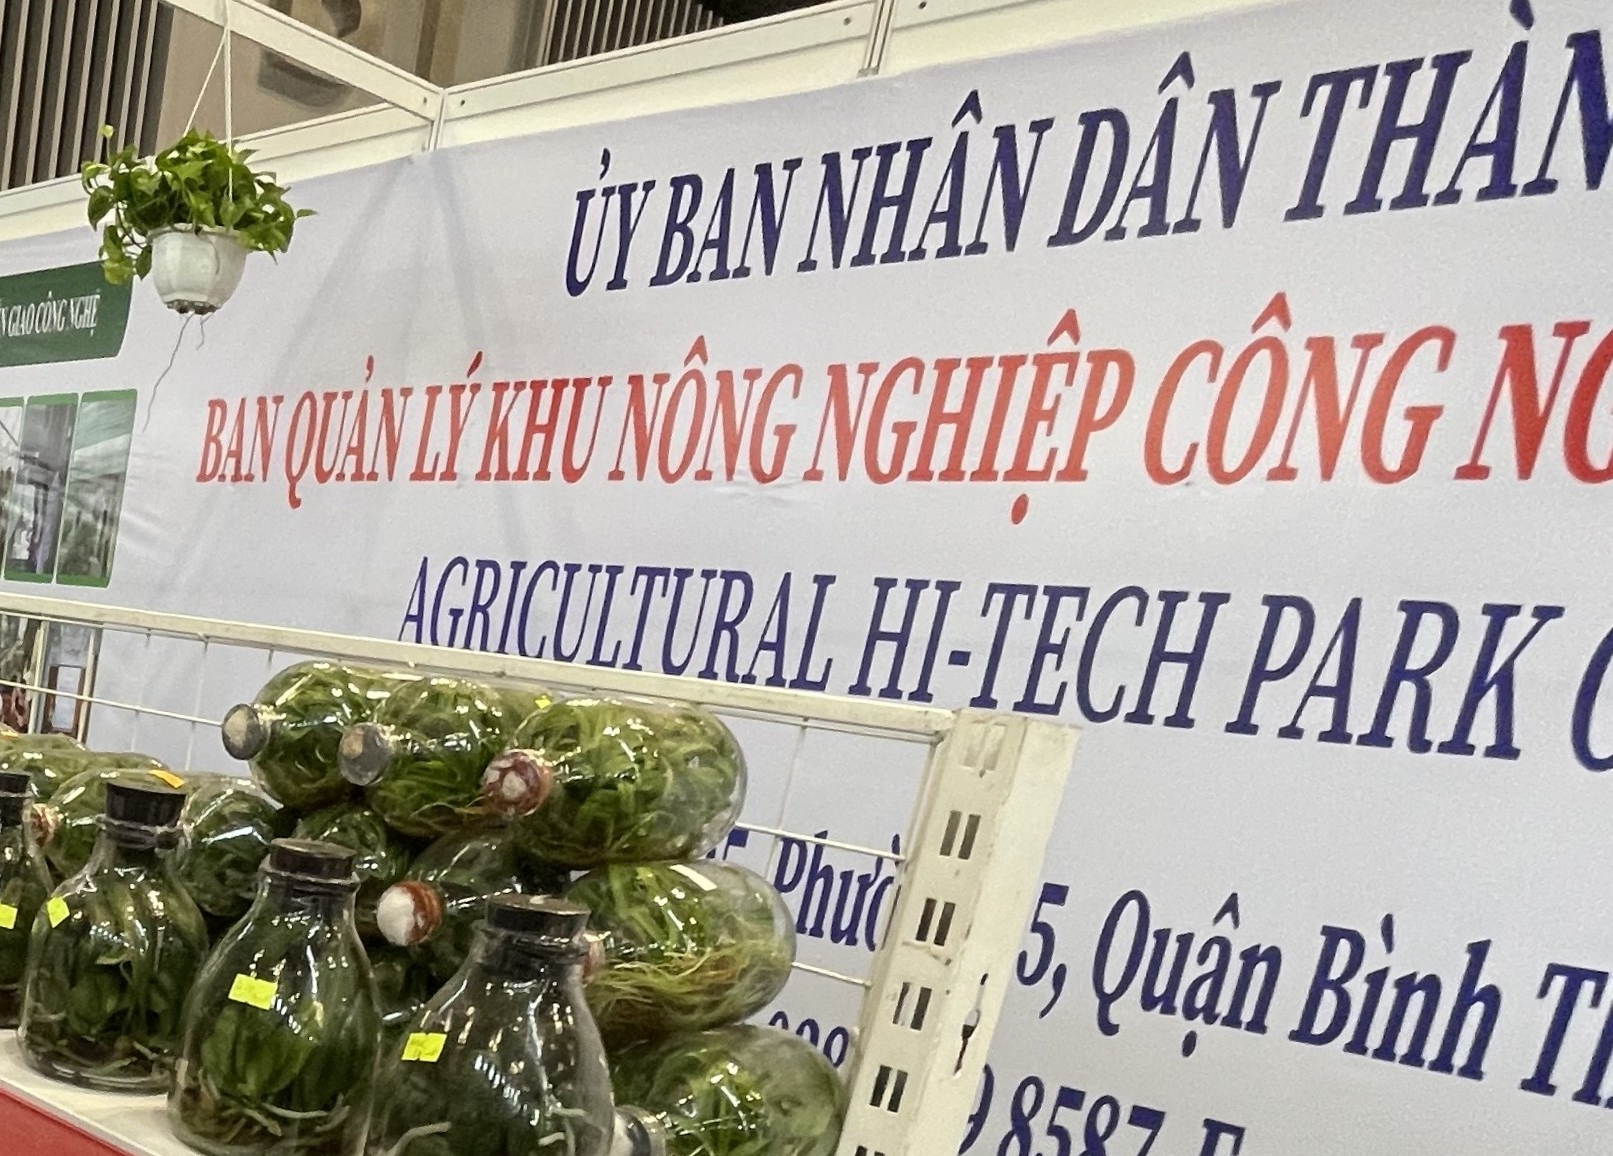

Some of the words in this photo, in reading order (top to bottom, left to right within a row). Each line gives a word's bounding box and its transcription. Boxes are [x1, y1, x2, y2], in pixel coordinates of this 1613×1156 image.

[564, 147, 658, 298] ỦY
[649, 157, 802, 288] BAN
[797, 88, 1053, 274] NHÂN
[1048, 50, 1282, 248] DÂN
[8, 303, 36, 337] GIAO
[35, 290, 68, 334] CÔNG
[195, 394, 285, 483] BAN
[285, 354, 414, 509] QUẢN
[409, 350, 483, 483] LÝ
[474, 375, 614, 485] KHU
[608, 336, 800, 485] NÔNG
[802, 308, 1136, 526] NGHIỆP
[1144, 291, 1458, 487] CÔNG
[397, 555, 837, 693] AGRICULTURAL
[847, 577, 1231, 730] HI-TECH
[1224, 595, 1566, 761] PARK
[1014, 882, 1071, 1020] 5,
[1092, 887, 1284, 1060] Quận
[1287, 912, 1503, 1082] Bình
